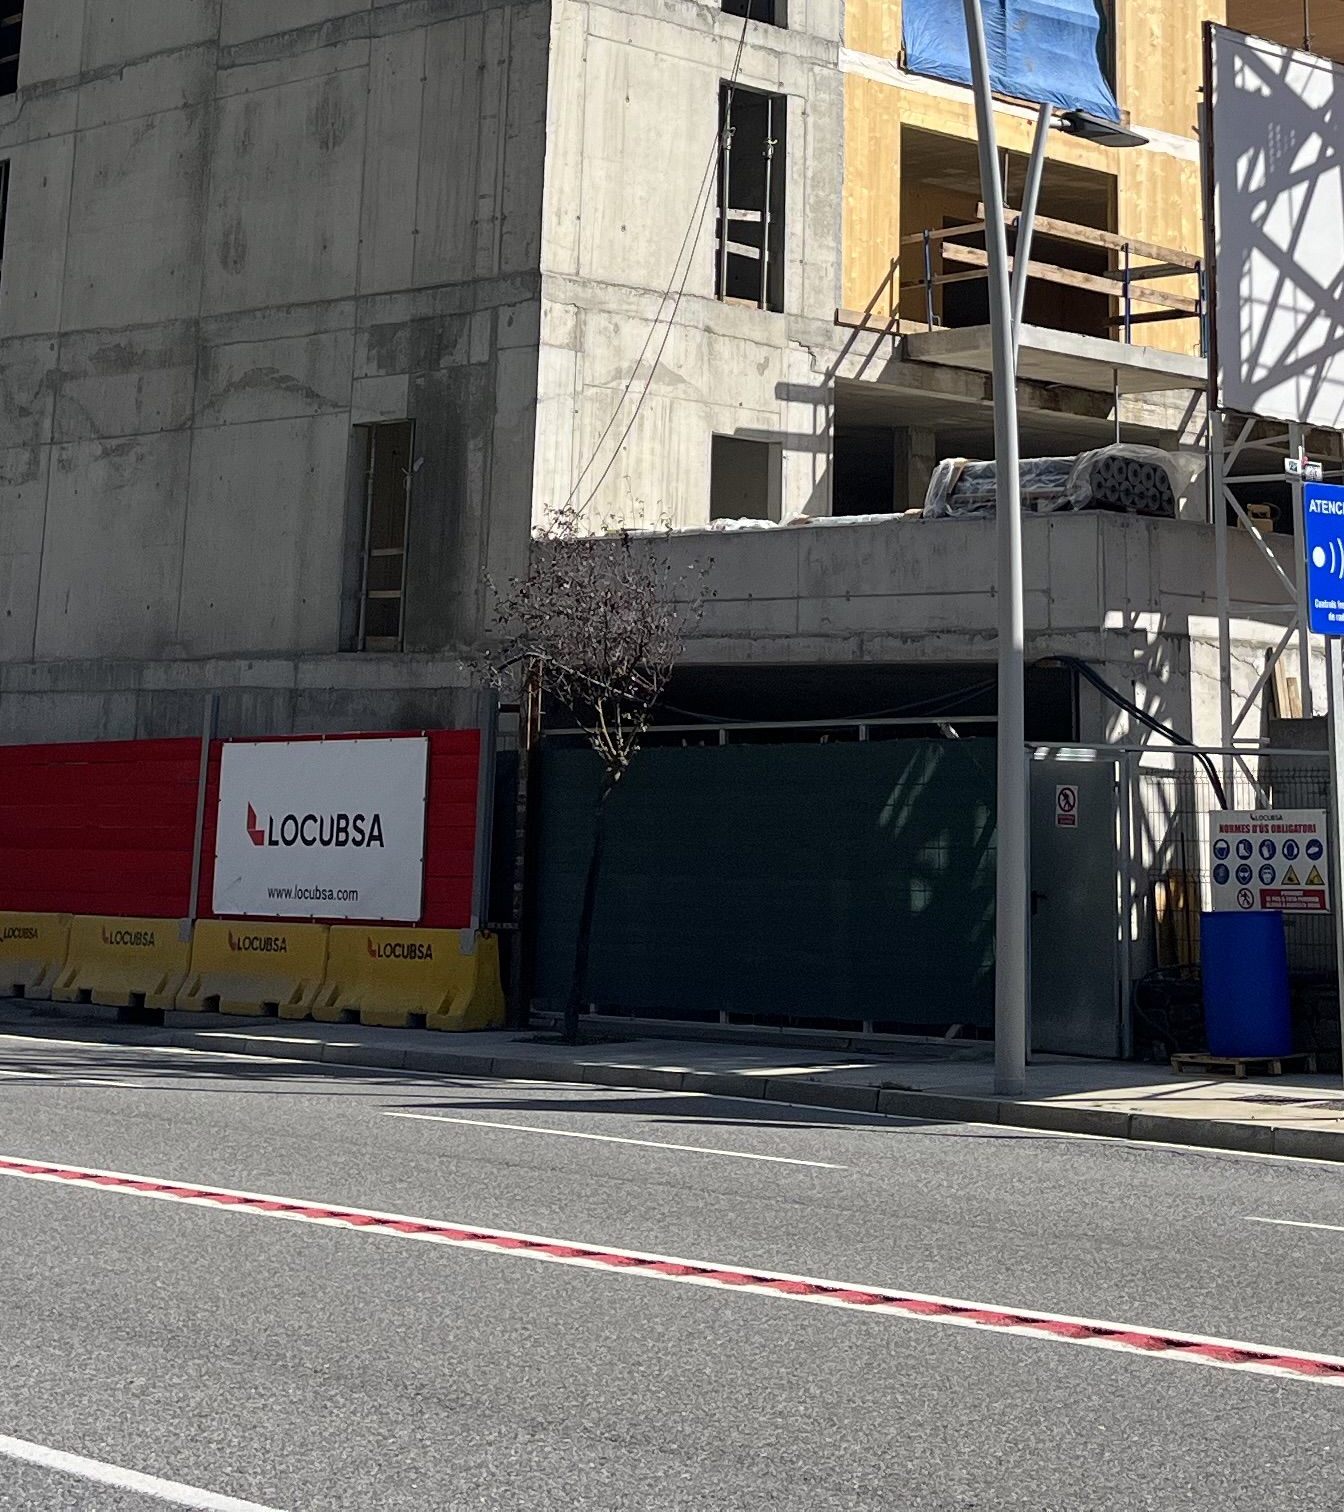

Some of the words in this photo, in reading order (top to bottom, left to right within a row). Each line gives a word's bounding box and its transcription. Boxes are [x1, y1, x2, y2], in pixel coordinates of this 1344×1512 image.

[268, 814, 384, 848] LOCUBSA
[268, 884, 358, 901] www.locubsa.com
[237, 936, 288, 953] LOCUBSA
[377, 943, 433, 960] LOCUBSA
